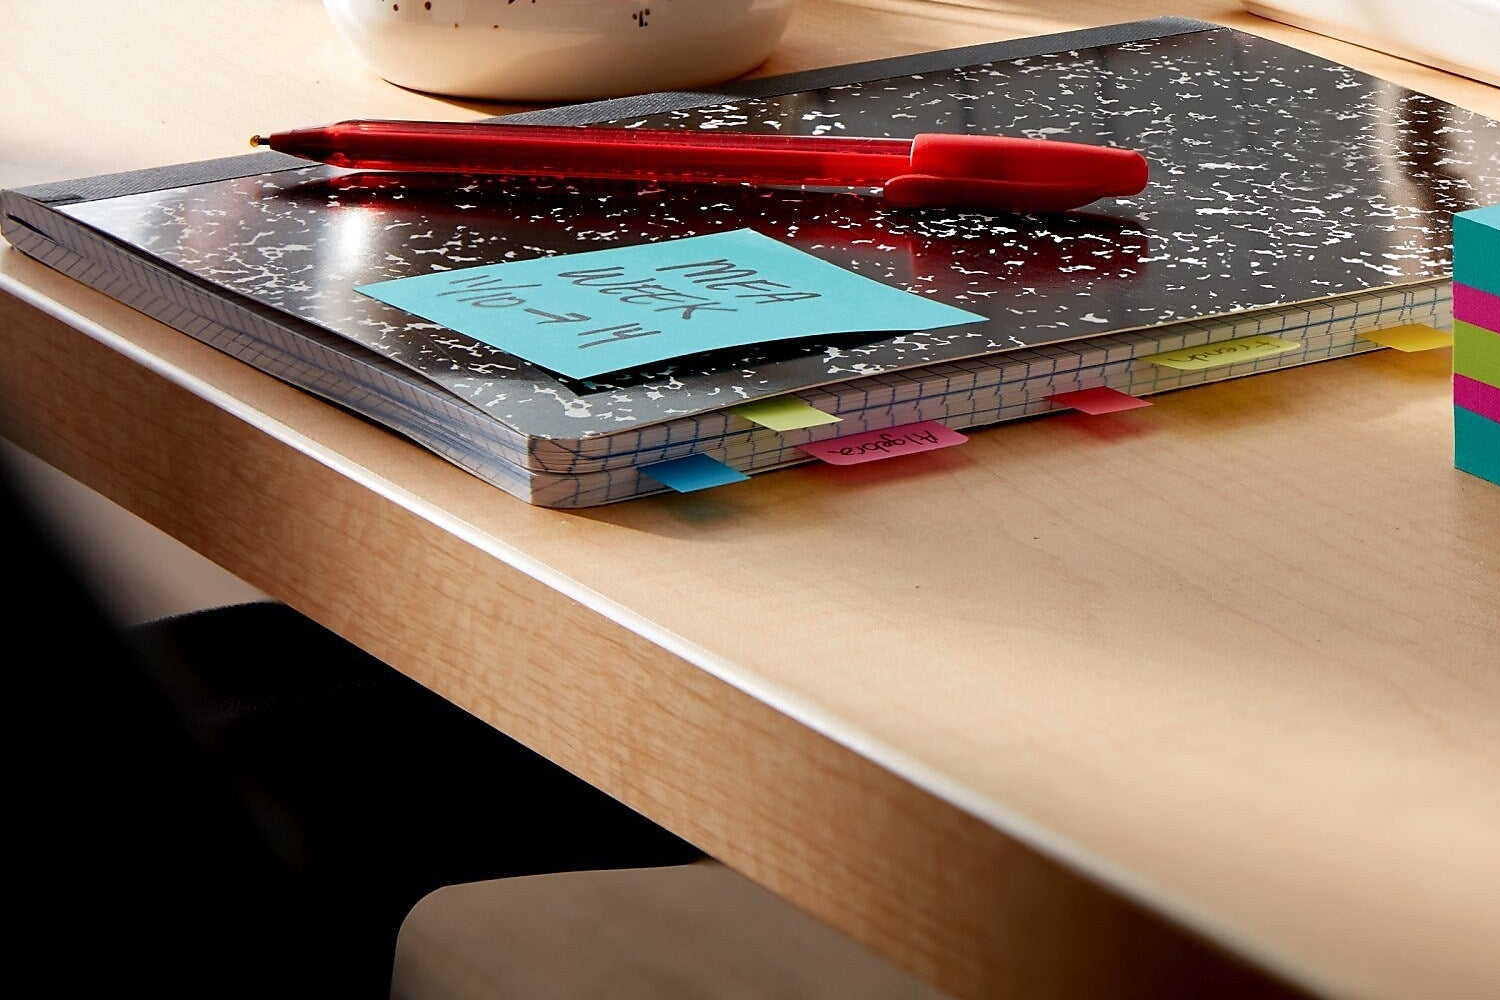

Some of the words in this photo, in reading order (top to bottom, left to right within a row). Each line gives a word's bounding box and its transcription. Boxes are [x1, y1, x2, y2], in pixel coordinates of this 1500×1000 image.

[436, 274, 543, 308] 11/10
[577, 322, 662, 350] 14
[557, 265, 738, 320] WEEK
[828, 429, 939, 457] Algebra
